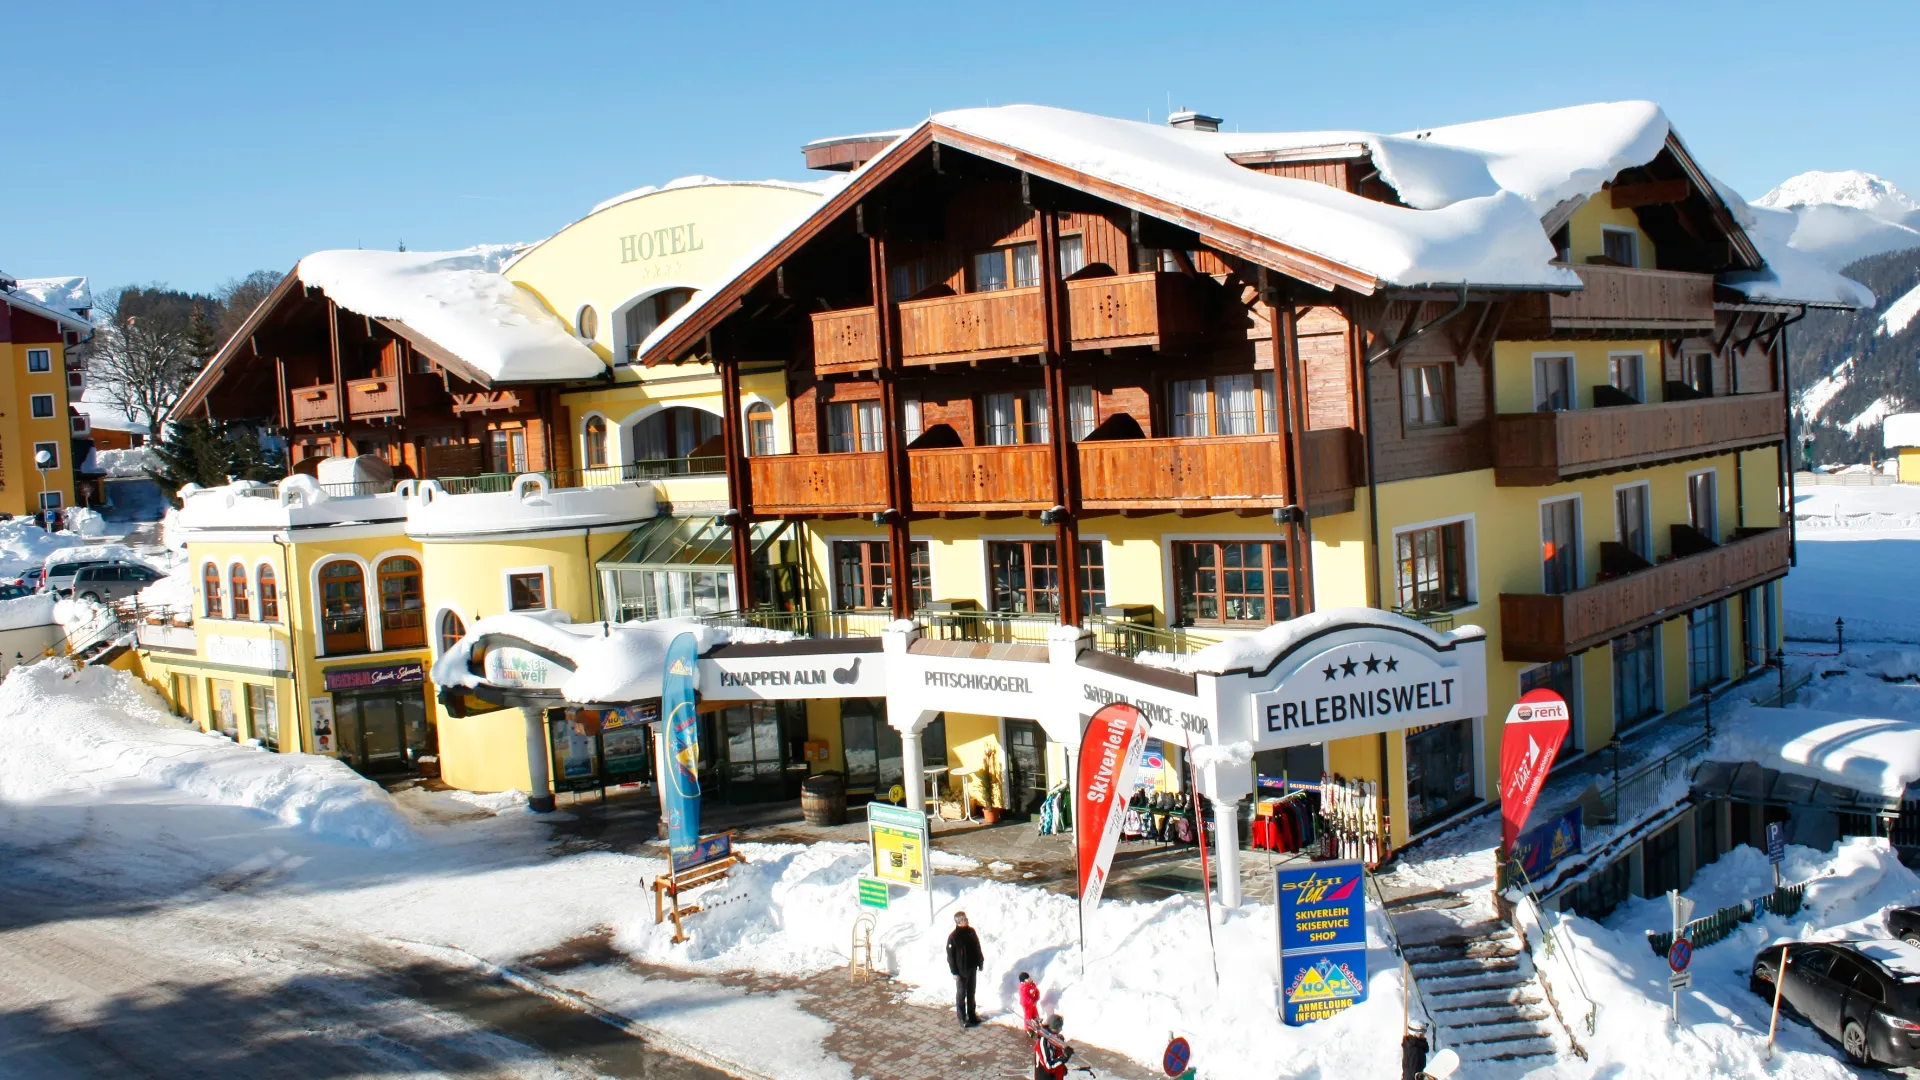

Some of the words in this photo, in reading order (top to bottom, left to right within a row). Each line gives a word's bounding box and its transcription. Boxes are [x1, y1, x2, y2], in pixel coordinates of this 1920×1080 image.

[619, 223, 704, 264] HOTEL
[46, 511, 52, 520] P
[720, 670, 790, 687] KNAPPEN
[794, 669, 826, 685] ALM
[1266, 678, 1455, 732] ERLEBNISWELT
[1534, 705, 1562, 719] rent
[1181, 711, 1208, 735] SHOP
[1087, 718, 1128, 803] Skiverleih
[893, 790, 899, 799] H
[1771, 825, 1778, 840] P
[1282, 877, 1342, 891] SCHI
[1295, 907, 1349, 920] SKIVERLEIH
[1296, 919, 1349, 932] SKISERVICE
[1310, 931, 1336, 941] SHOP
[1341, 963, 1363, 991] Schule
[1298, 998, 1353, 1012] ANMELDUNG
